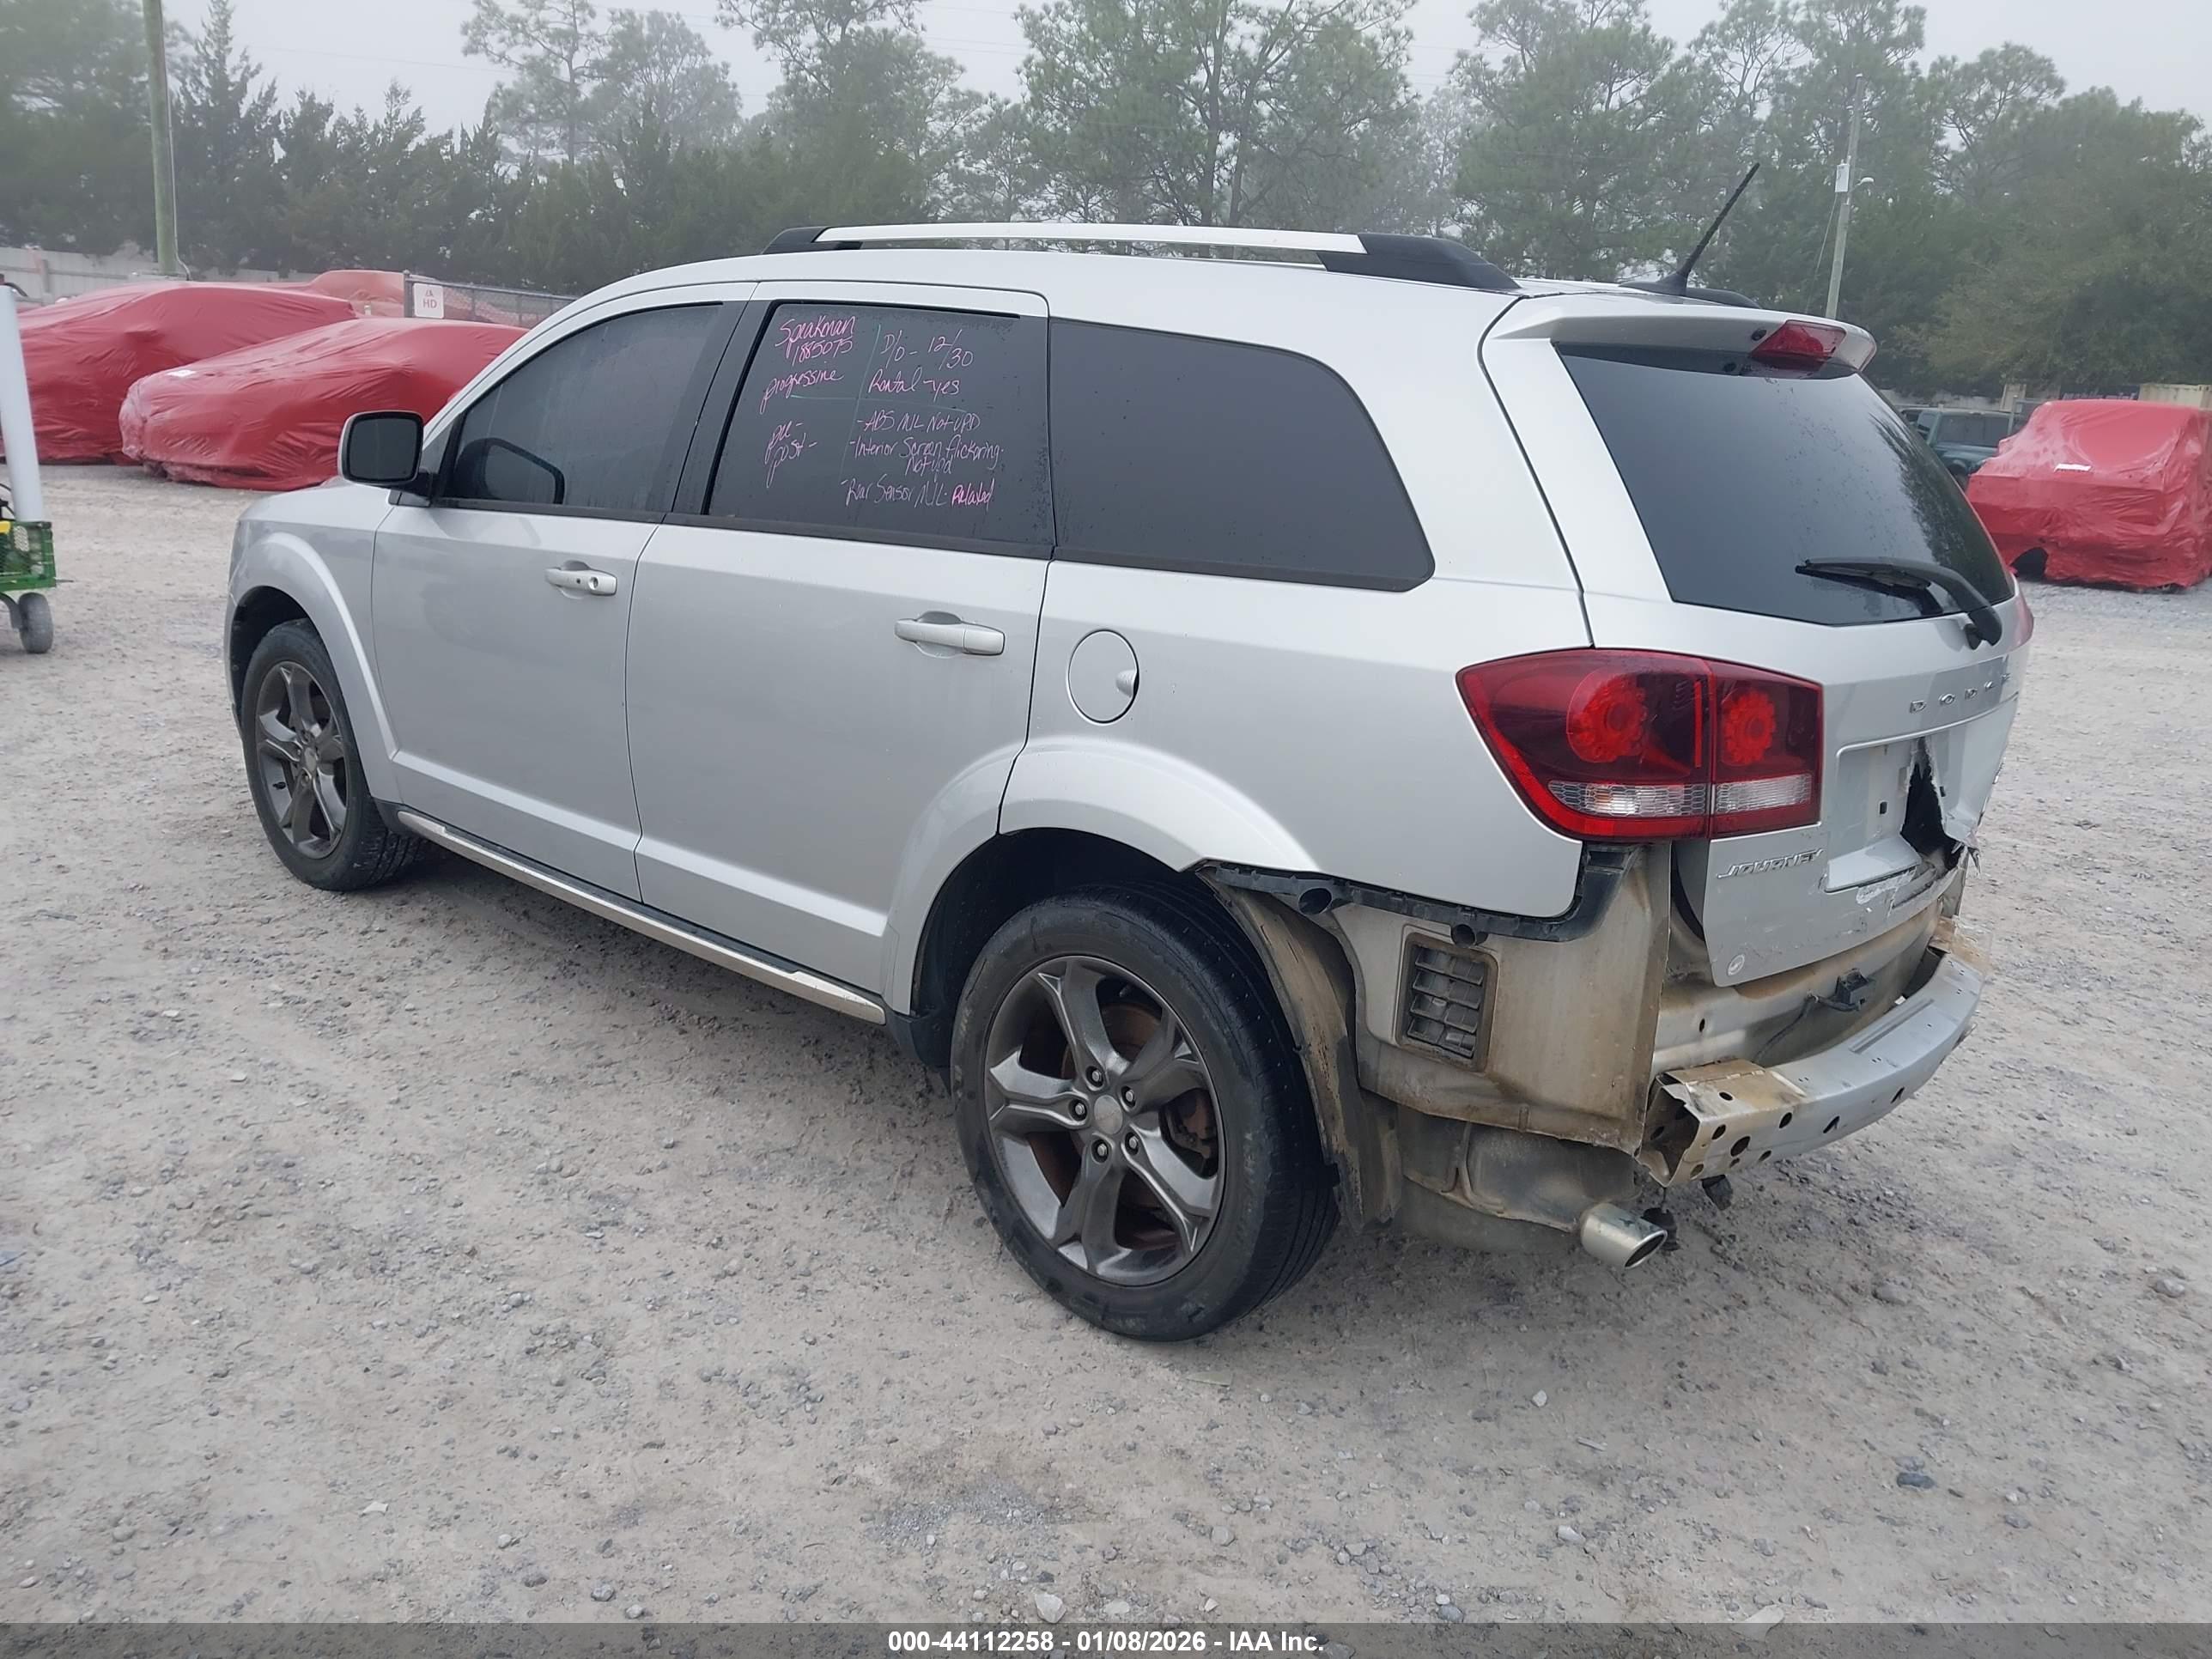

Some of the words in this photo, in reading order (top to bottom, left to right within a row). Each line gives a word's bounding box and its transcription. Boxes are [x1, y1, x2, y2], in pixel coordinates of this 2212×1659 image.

[422, 298, 438, 309] HD
[927, 329, 974, 370] 12/30
[867, 366, 923, 394] Rental
[1717, 848, 1824, 880] JOURNEY
